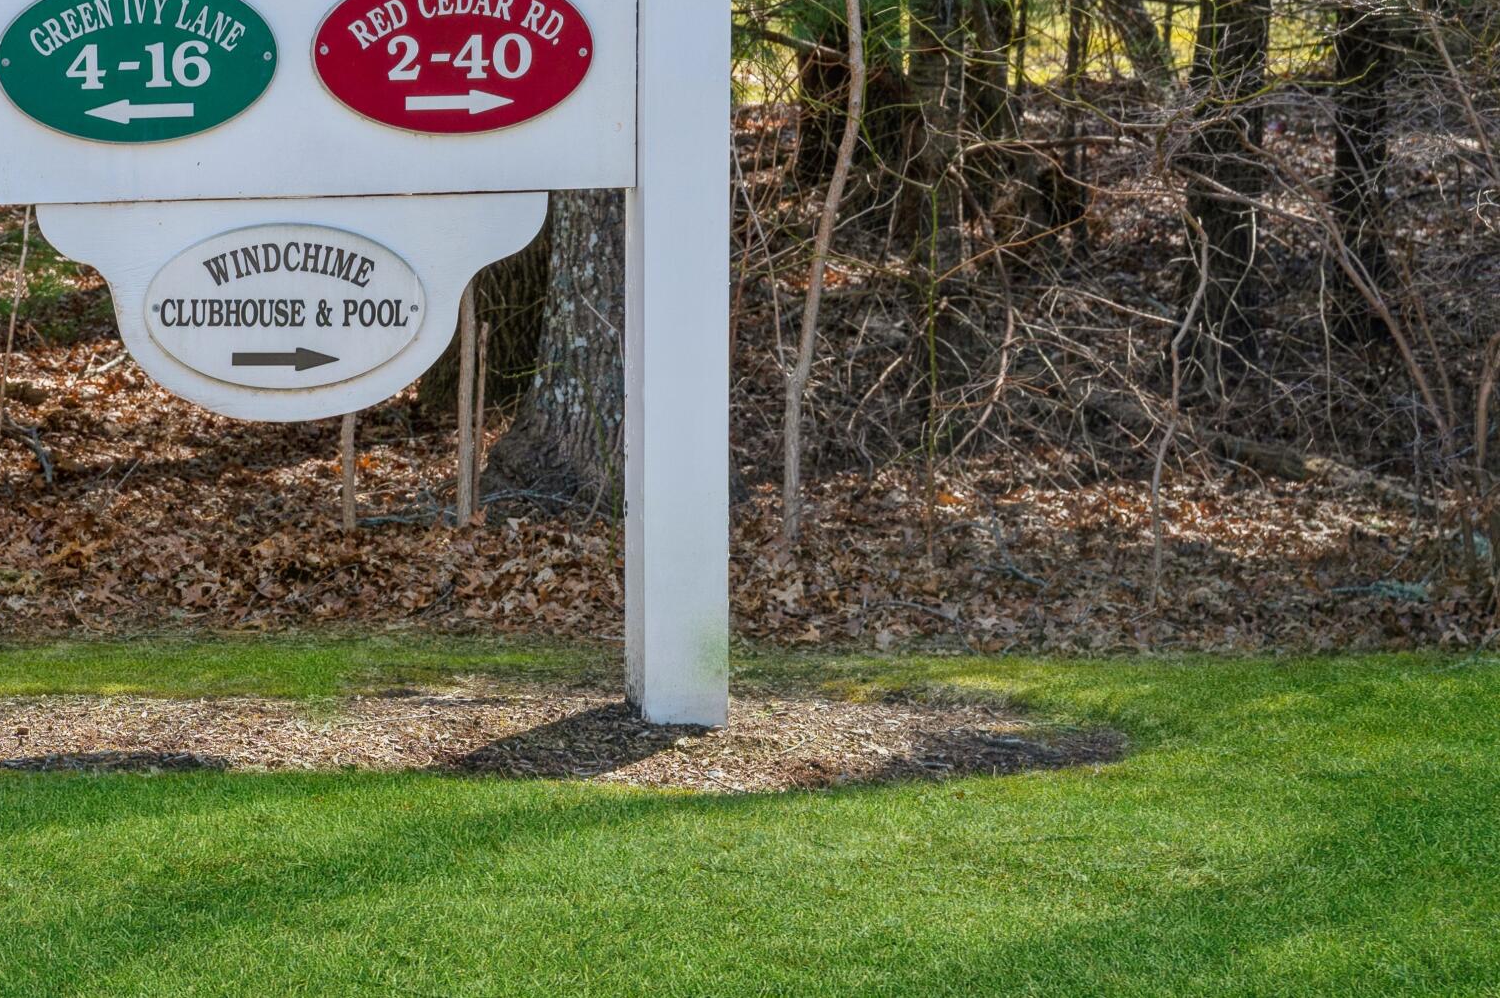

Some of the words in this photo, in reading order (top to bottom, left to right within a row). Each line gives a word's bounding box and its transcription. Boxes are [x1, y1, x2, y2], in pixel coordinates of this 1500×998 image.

[29, 1, 114, 57] GREEN
[347, 0, 406, 50] RED
[66, 40, 212, 90] 4-16
[387, 33, 532, 81] 2-40
[203, 242, 375, 288] WINDCHIME
[160, 298, 305, 327] CLUBHOUSE
[316, 299, 332, 327] &
[343, 299, 409, 327] POOL
